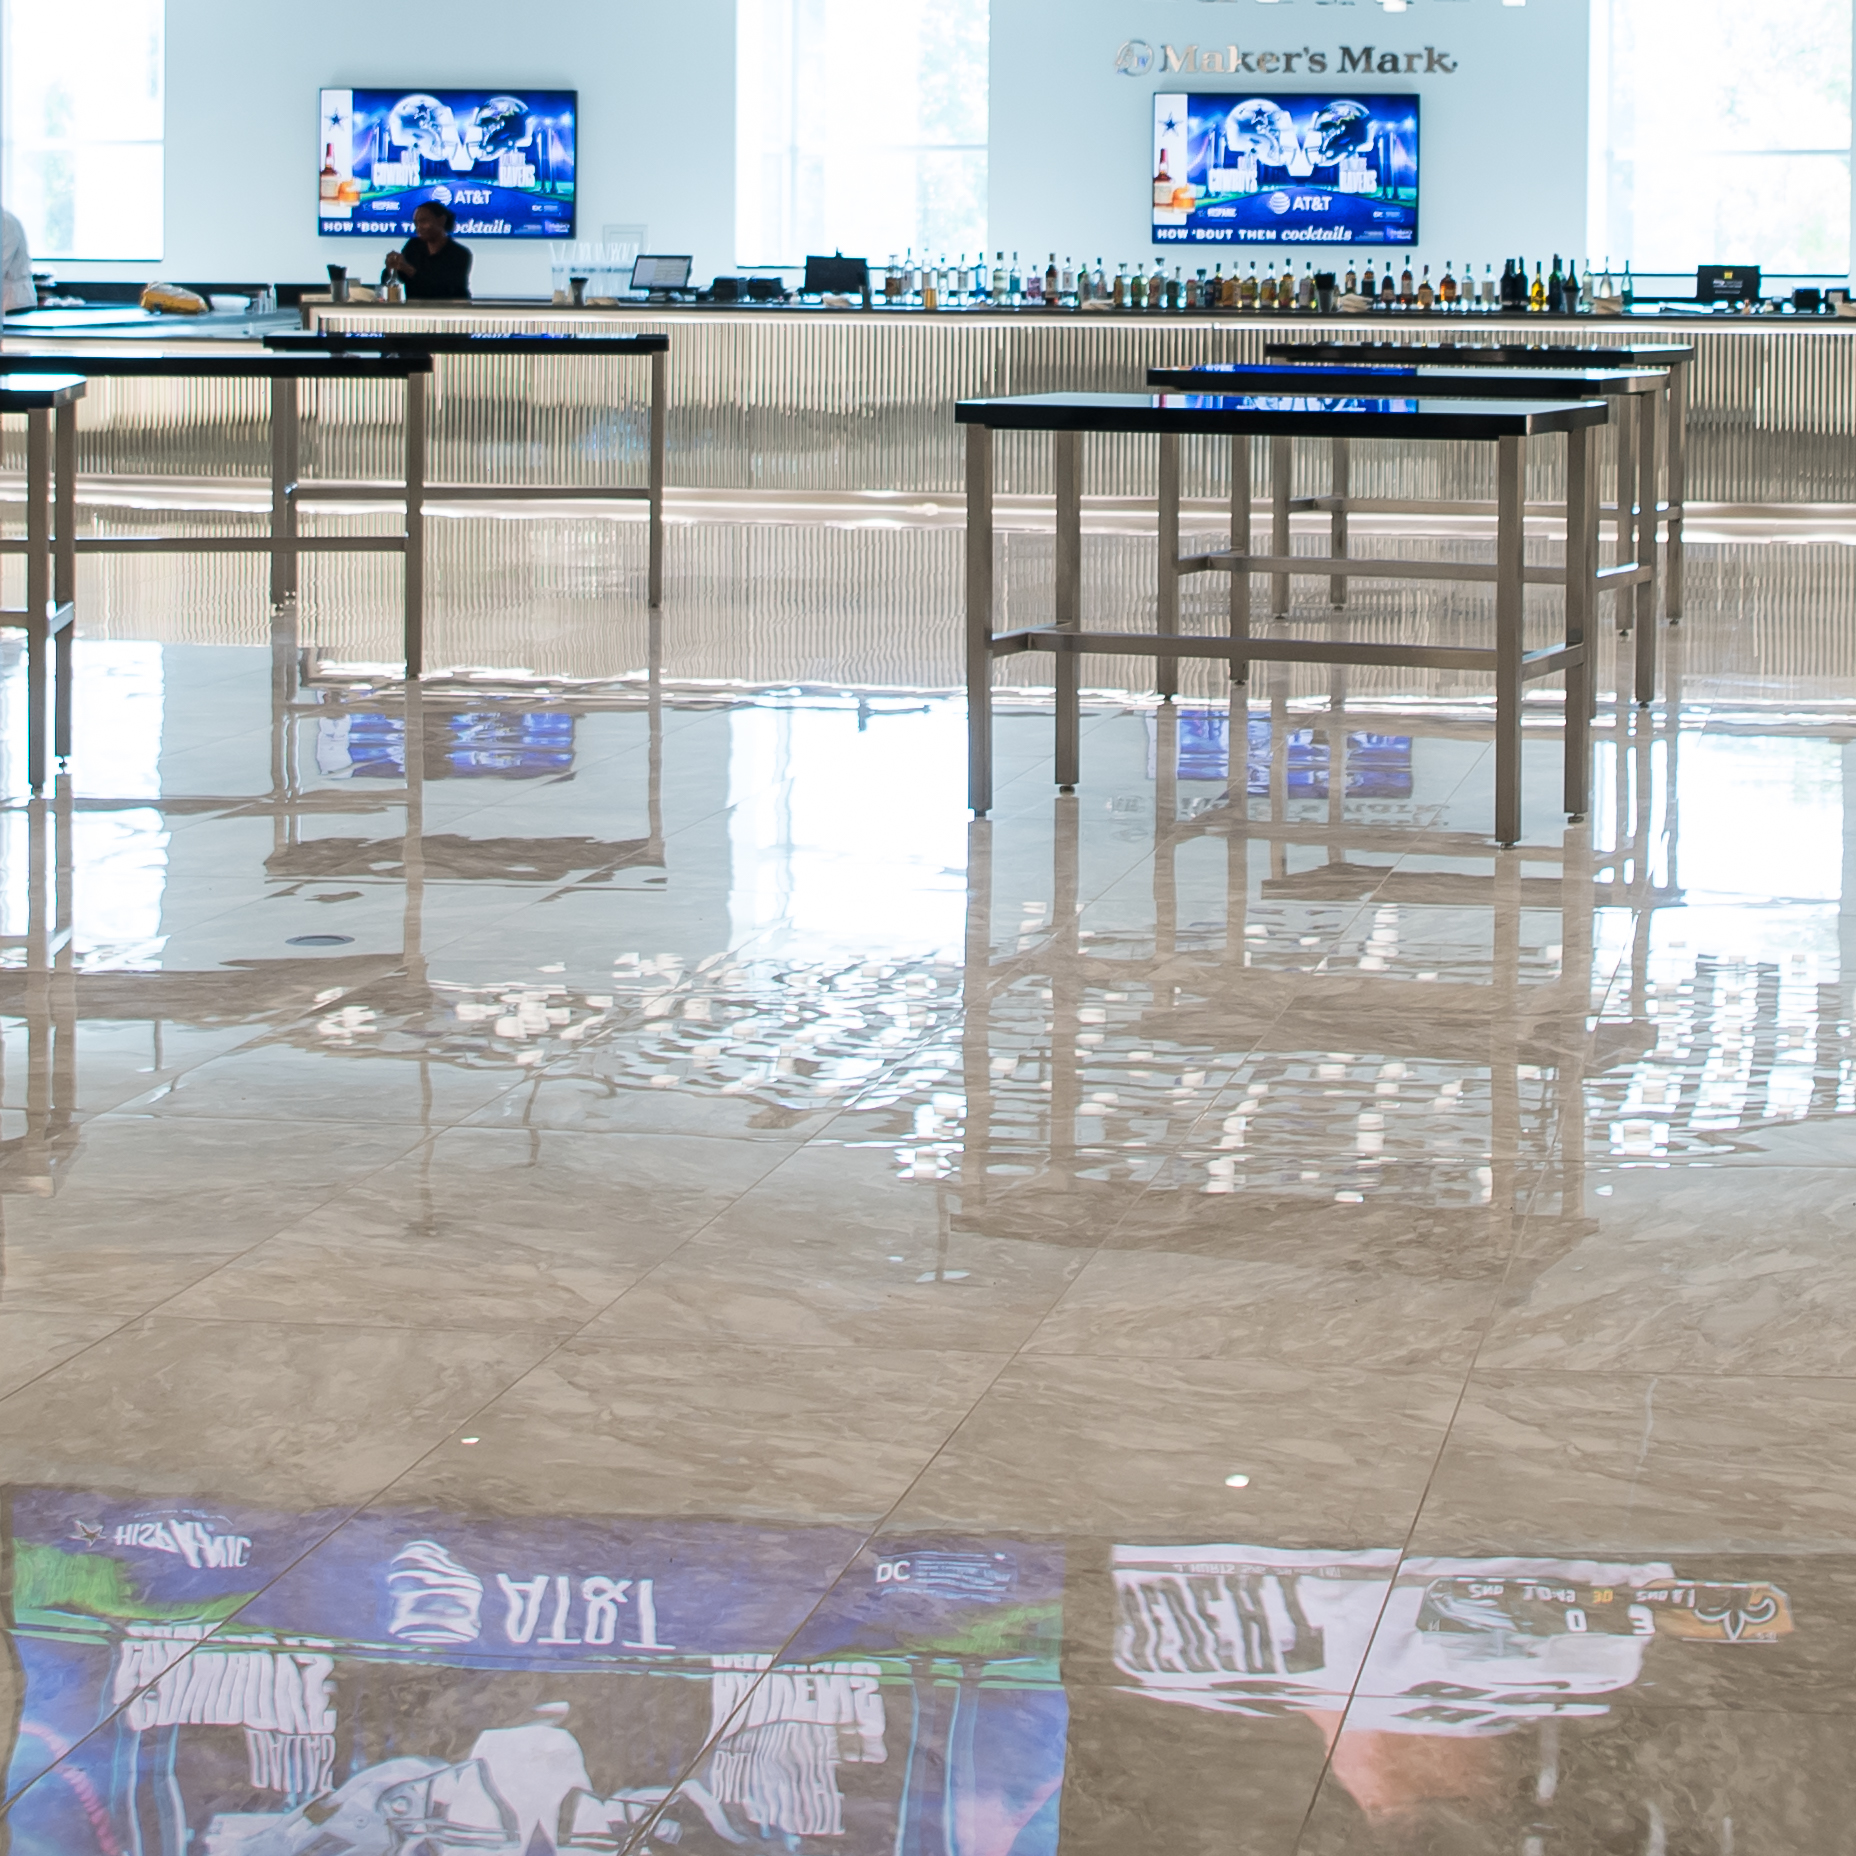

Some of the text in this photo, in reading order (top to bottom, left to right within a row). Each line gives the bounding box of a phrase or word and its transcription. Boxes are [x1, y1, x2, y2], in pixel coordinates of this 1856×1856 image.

[1159, 44, 1328, 73] Maker's
[454, 190, 492, 204] AT&T
[1293, 196, 1332, 211] AT&T
[323, 222, 354, 232] HOW
[357, 221, 397, 233] 'BOUT
[453, 218, 512, 234] ocktails
[1157, 229, 1188, 240] HOW
[1192, 228, 1233, 240] 'BOUT
[1238, 229, 1277, 240] THEM
[1281, 225, 1352, 241] cocktails
